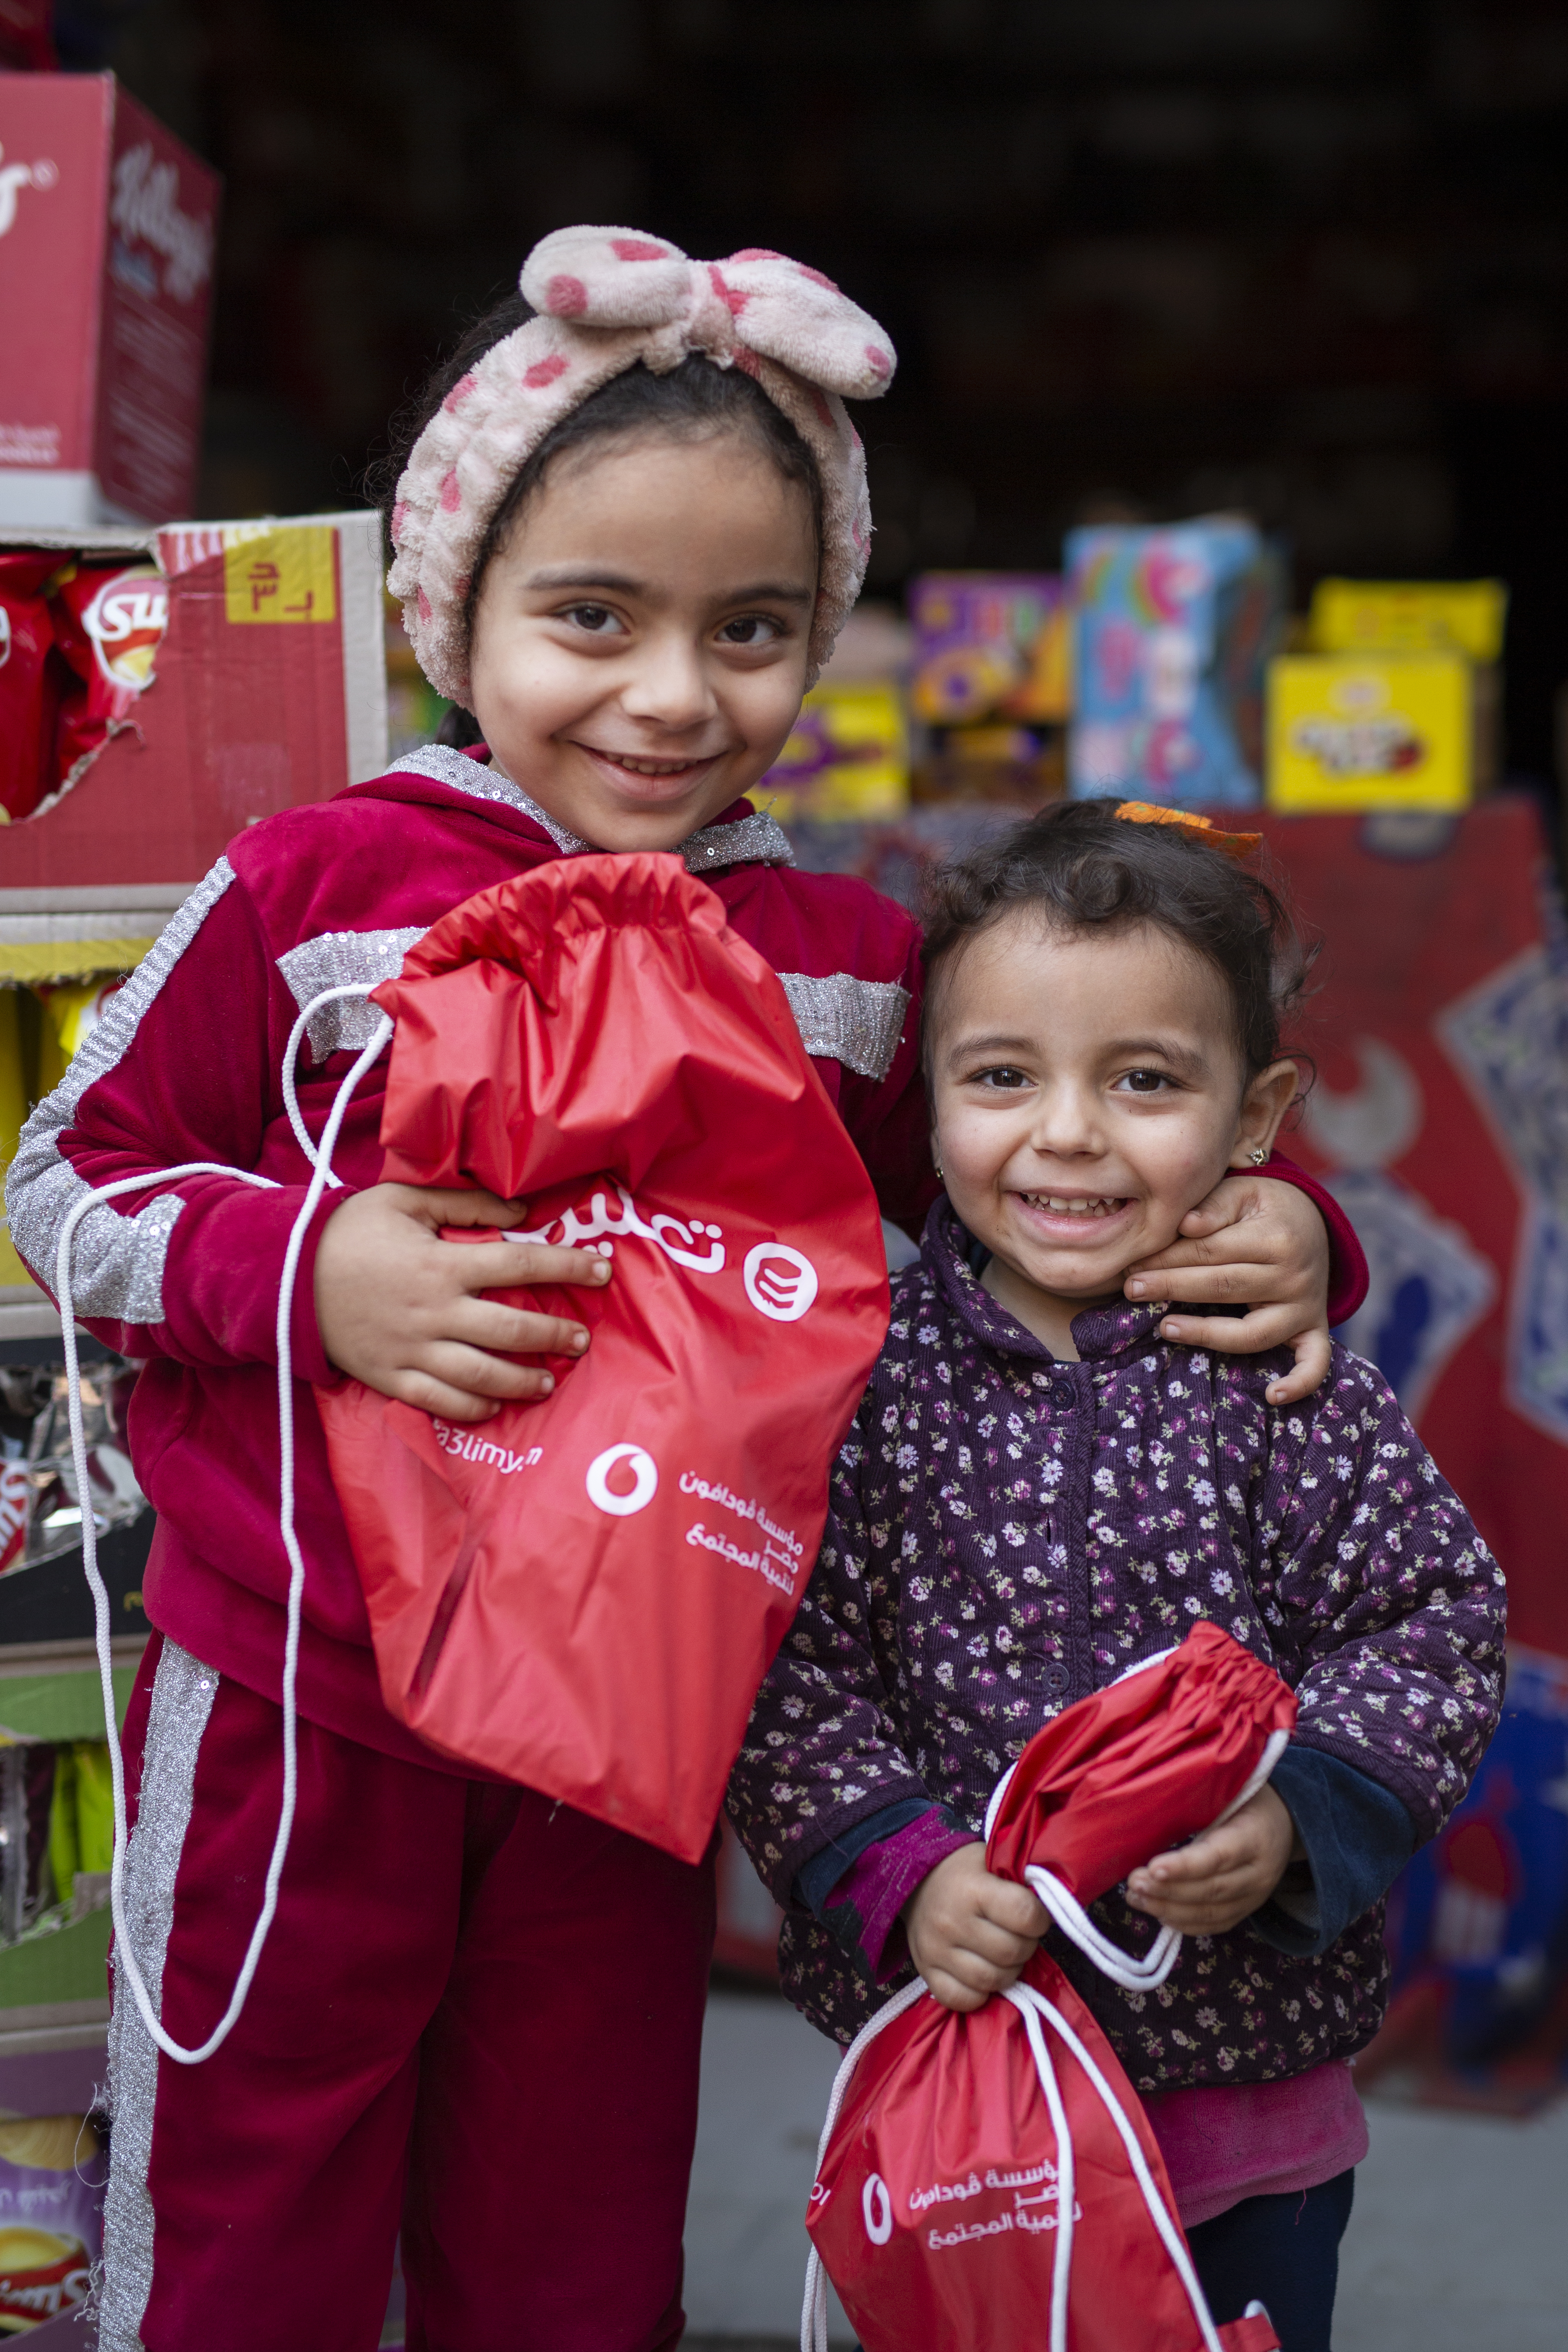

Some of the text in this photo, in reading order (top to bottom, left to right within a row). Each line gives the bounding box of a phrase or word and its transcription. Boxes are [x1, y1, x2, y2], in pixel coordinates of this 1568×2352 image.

[685, 1522, 761, 1571] المجتمع
[985, 2158, 1059, 2188] ؤسسة
[928, 2212, 1013, 2250] المجتمع
